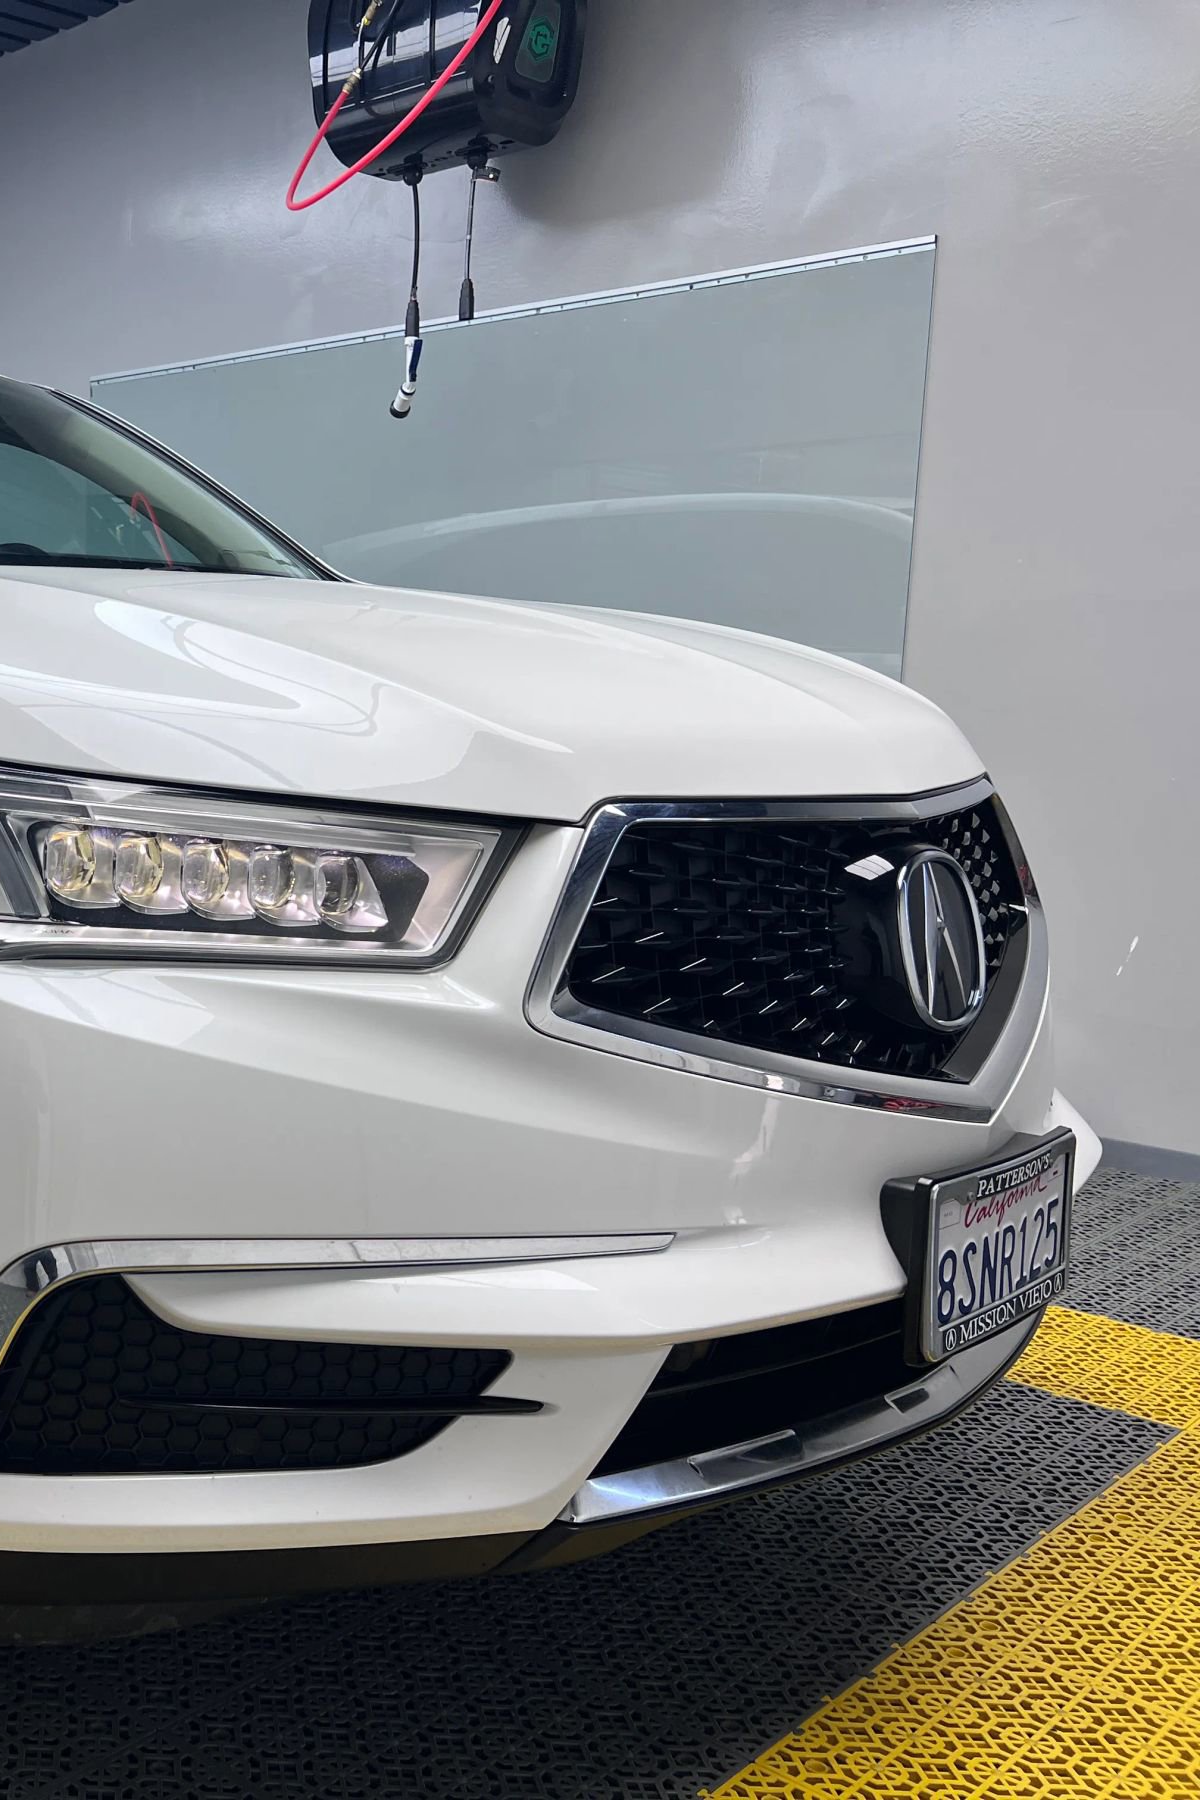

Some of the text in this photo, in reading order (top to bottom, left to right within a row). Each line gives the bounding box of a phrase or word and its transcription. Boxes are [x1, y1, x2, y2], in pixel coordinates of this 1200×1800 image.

[964, 1176, 1047, 1228] California
[976, 1153, 1050, 1198] PATTERSON'S
[937, 1198, 1058, 1324] 8SNR125
[959, 1280, 1052, 1344] MISSION VIEJO
